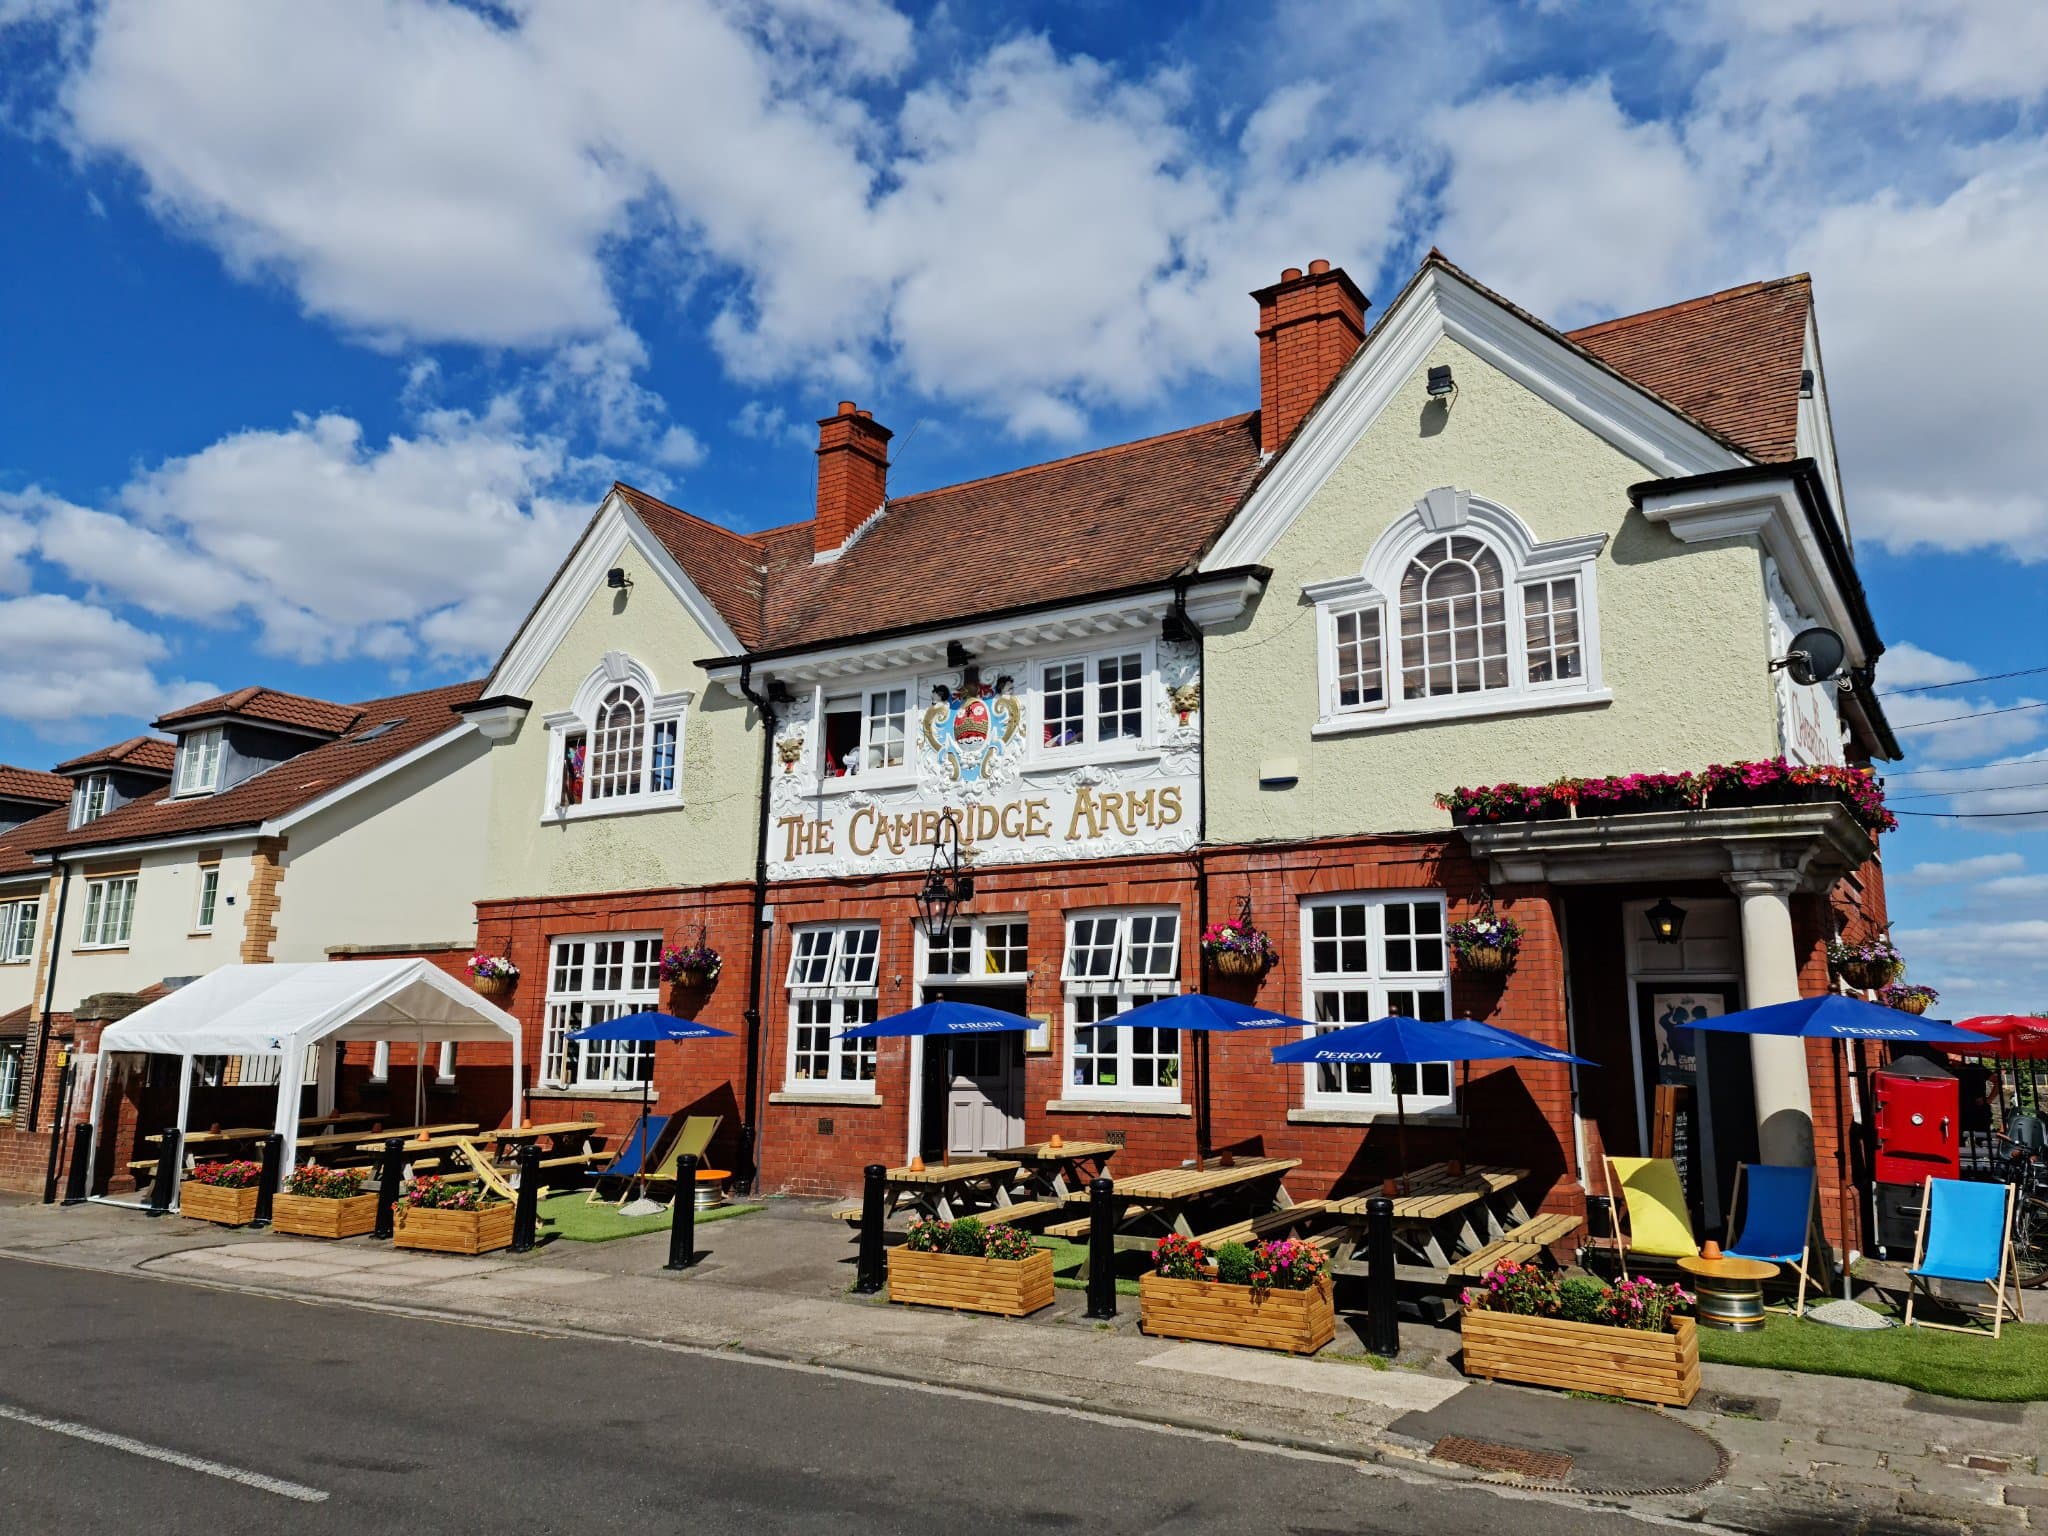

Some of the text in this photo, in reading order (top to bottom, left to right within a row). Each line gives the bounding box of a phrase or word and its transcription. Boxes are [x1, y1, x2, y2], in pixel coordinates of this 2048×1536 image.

[777, 785, 1184, 862] THE CAMBRIDGE ARMS
[947, 1021, 1005, 1031] PERONI
[1831, 1025, 1921, 1037] PERONI
[1315, 1050, 1383, 1060] PERONI
